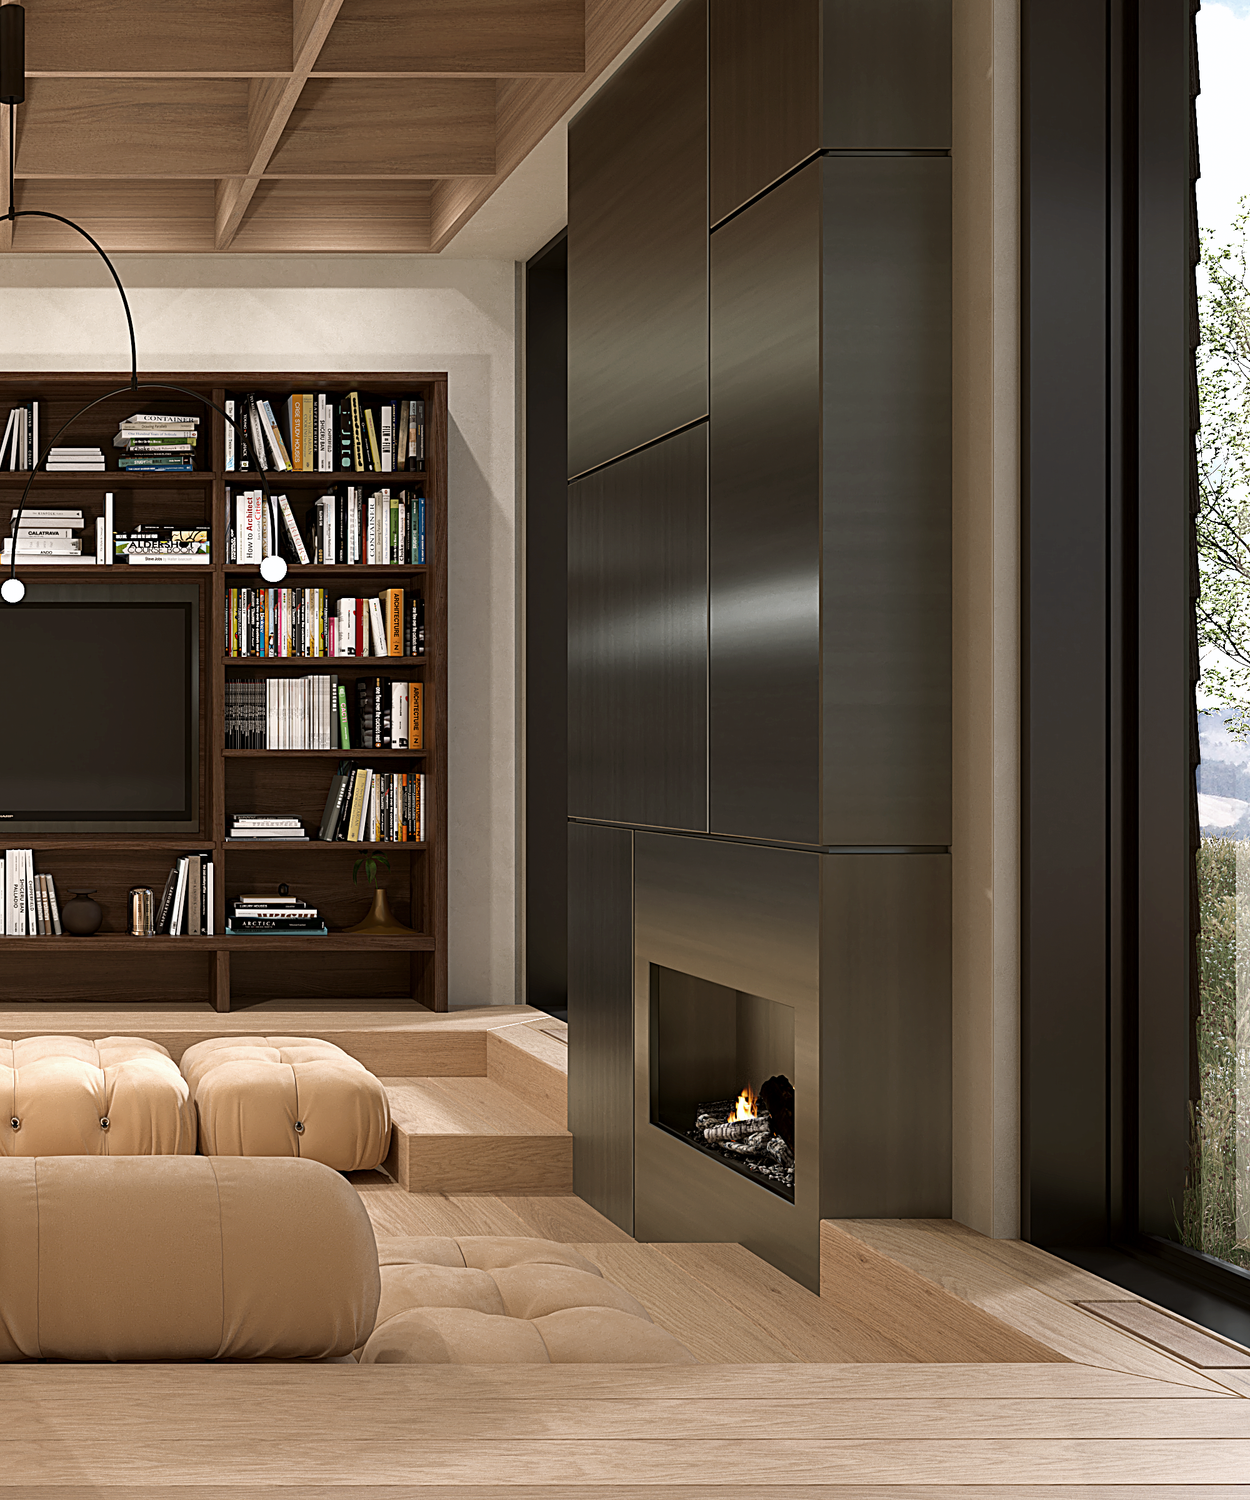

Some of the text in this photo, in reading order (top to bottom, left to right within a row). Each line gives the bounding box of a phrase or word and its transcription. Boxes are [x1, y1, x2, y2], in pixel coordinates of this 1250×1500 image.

[143, 415, 194, 423] CONTAINER
[254, 496, 262, 520] Cities
[128, 541, 194, 549] ALDERSHOT
[159, 886, 174, 927] MAPPLETHORPE
